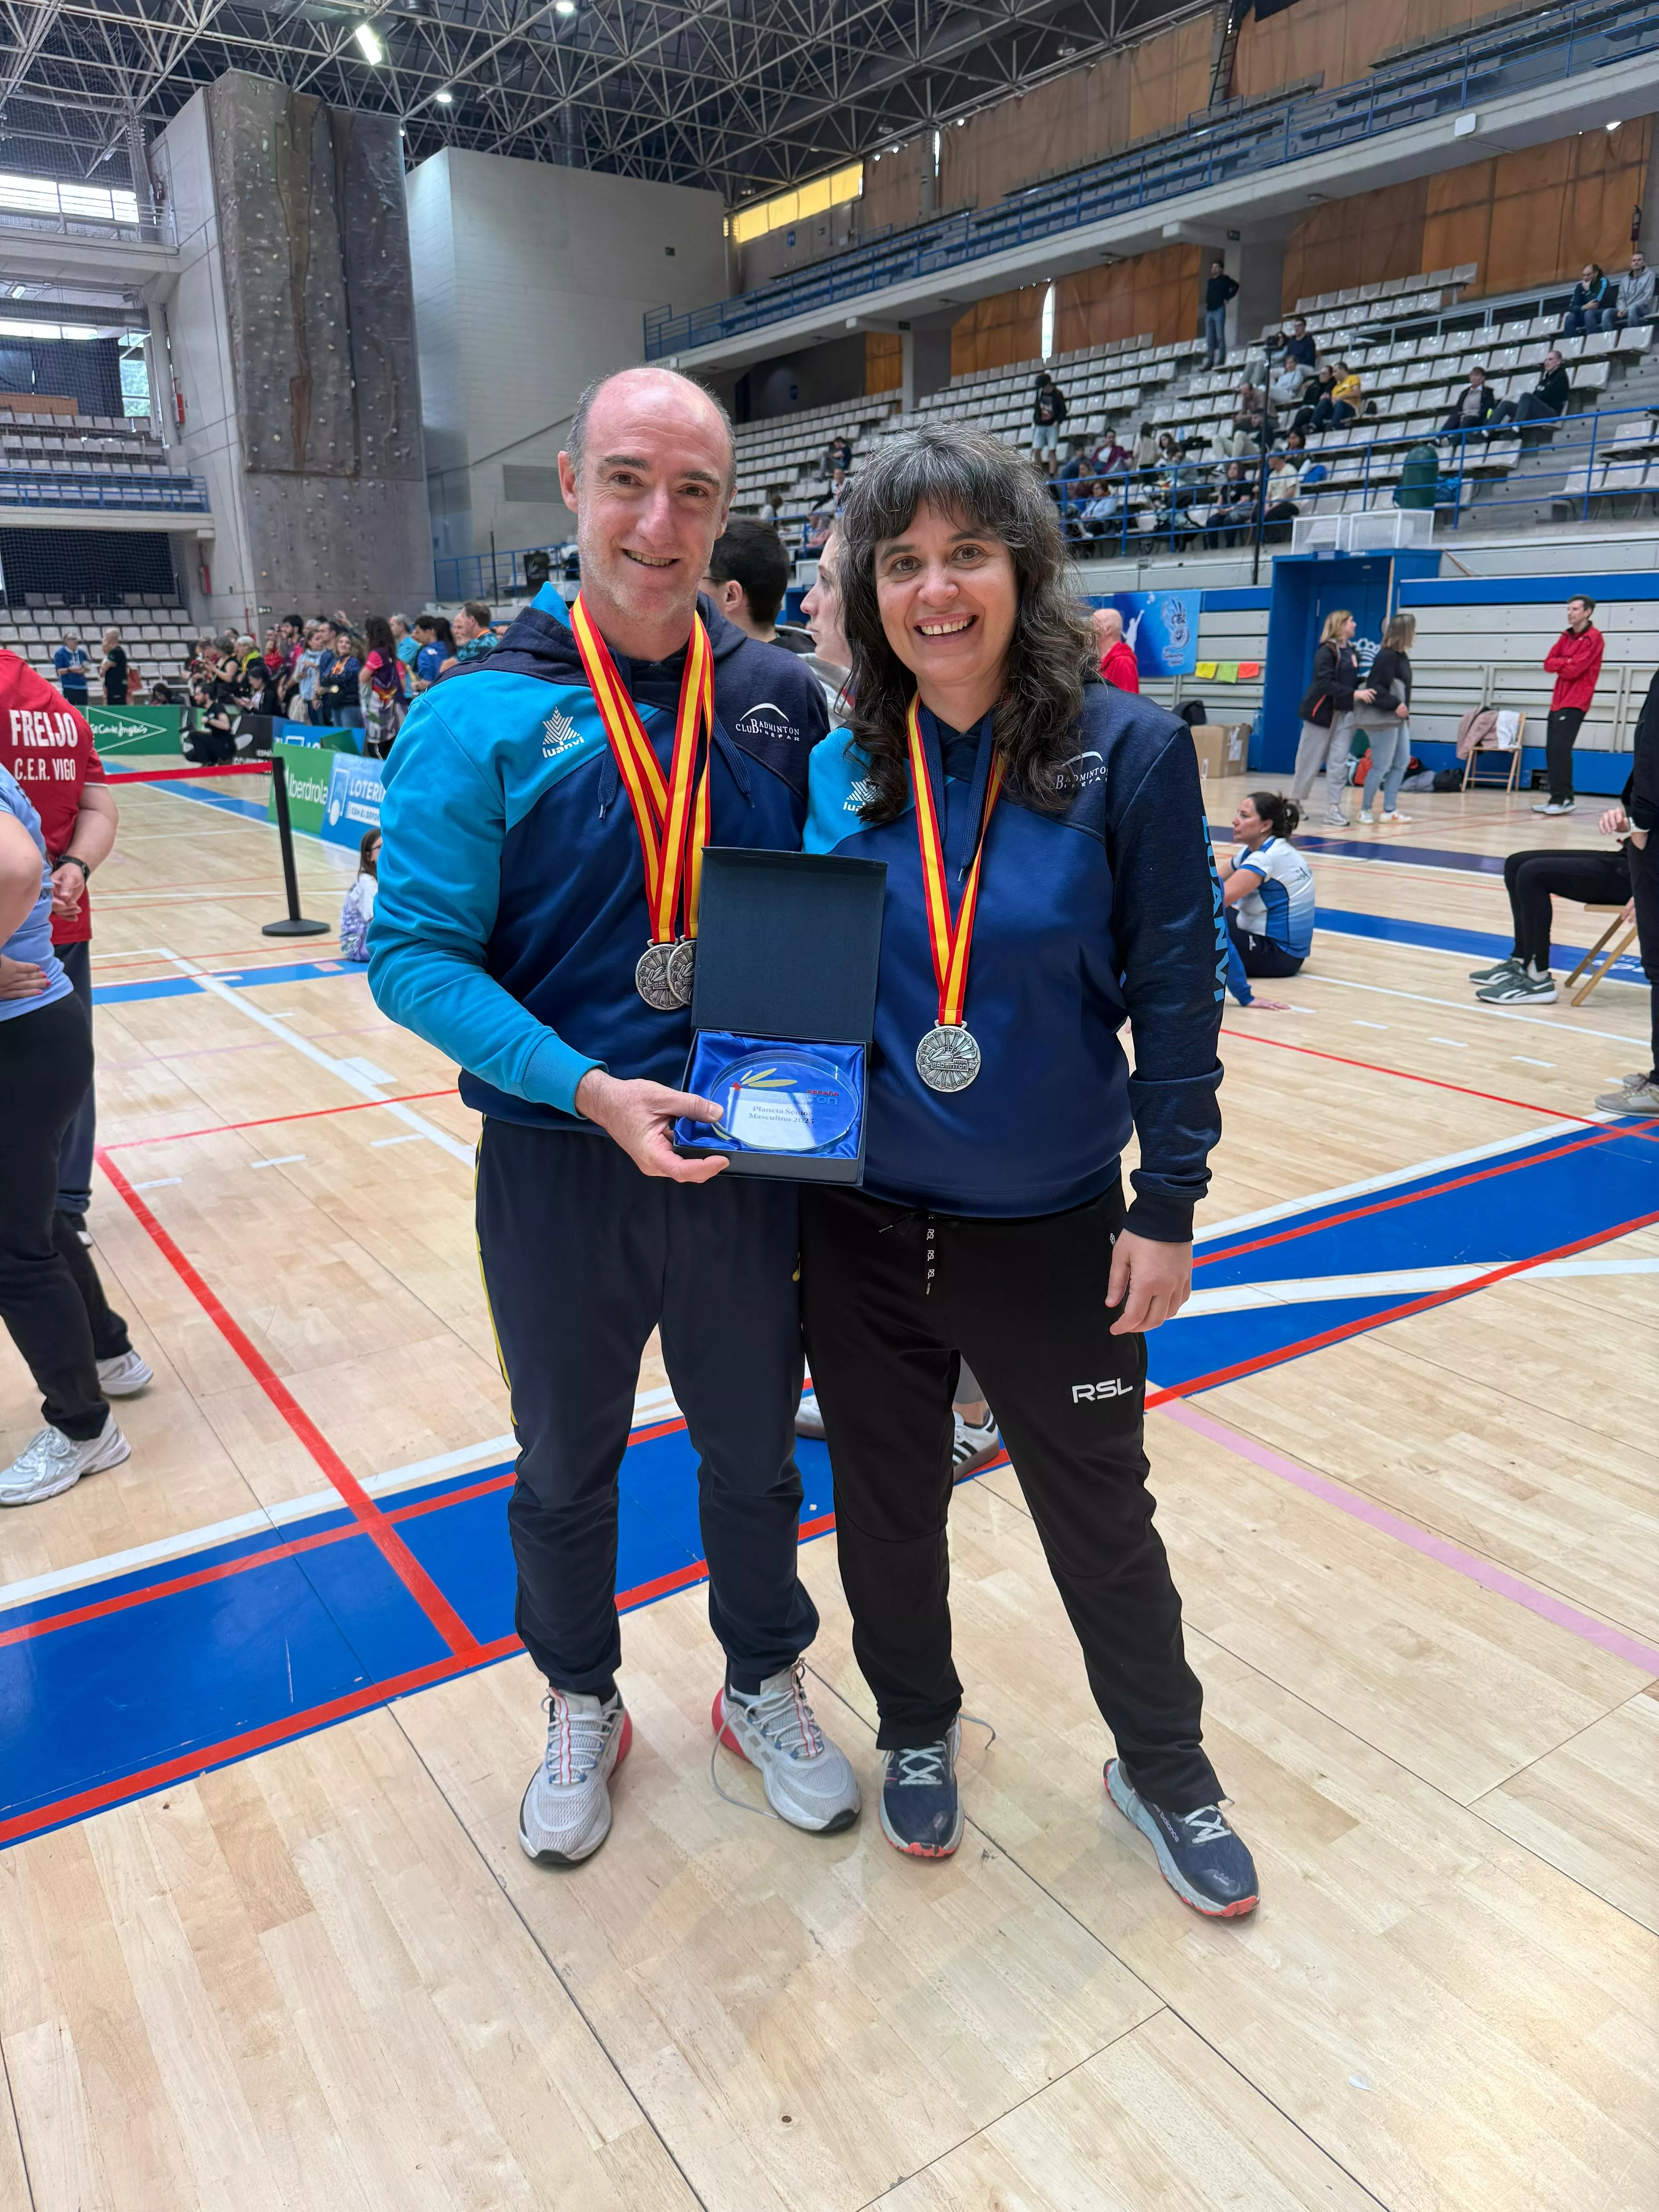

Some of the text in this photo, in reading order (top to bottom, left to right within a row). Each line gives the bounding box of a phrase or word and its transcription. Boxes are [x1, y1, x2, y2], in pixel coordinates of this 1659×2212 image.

[9, 709, 78, 747] FREIJO
[542, 736, 585, 758] luanvi
[14, 758, 76, 781] C.E.R. VIGO
[288, 772, 328, 805] Iberdrola
[748, 1112, 791, 1122] Masculino
[753, 1105, 784, 1114] Planeta
[926, 1229, 934, 1241] RSL
[1071, 1378, 1134, 1404] RSL
[1160, 1811, 1179, 1843] balance
